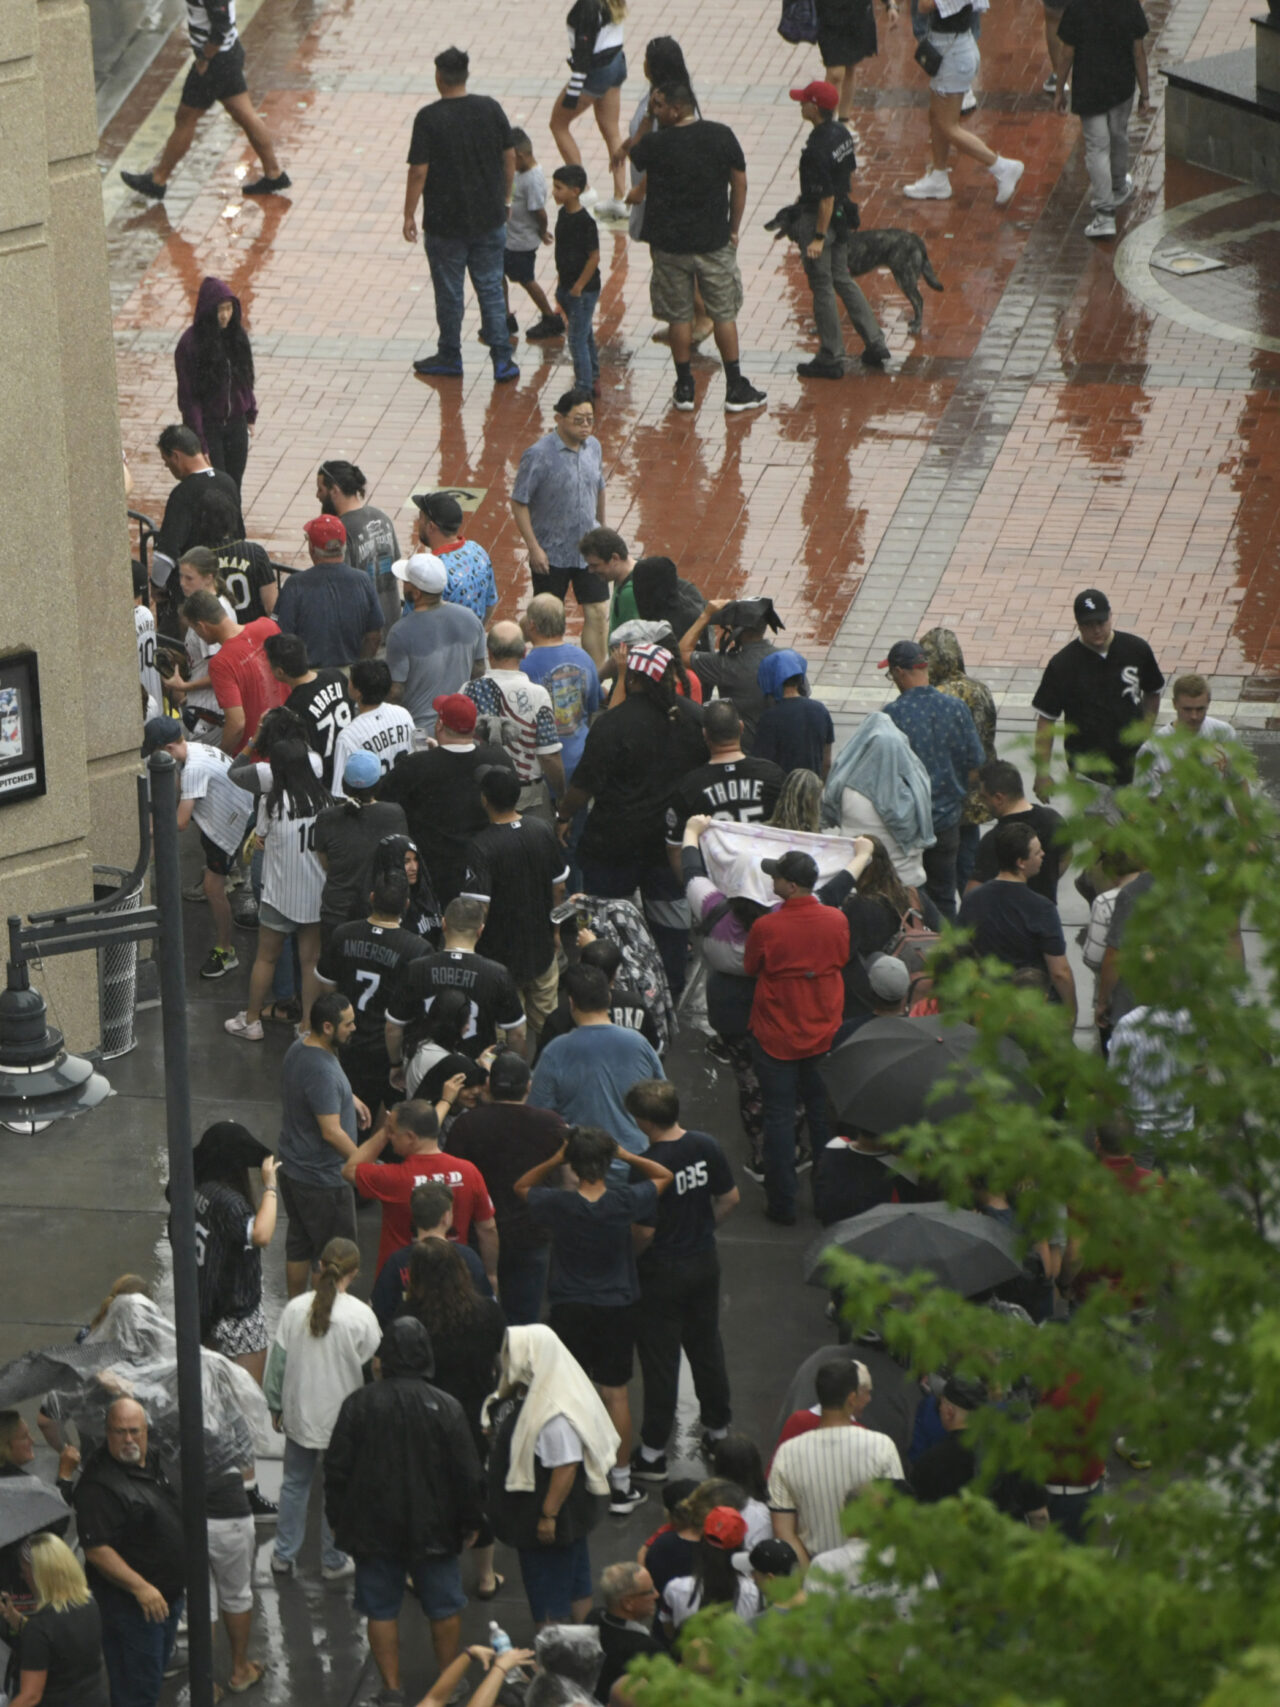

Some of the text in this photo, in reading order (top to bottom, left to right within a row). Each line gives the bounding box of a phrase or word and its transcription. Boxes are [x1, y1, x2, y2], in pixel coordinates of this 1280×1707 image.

[308, 681, 343, 719] ABREU
[316, 701, 352, 758] 79
[362, 724, 409, 753] ROBERT
[0, 772, 34, 788] PITCHER
[703, 779, 764, 806] THOME
[344, 939, 400, 969] ANDERSON
[356, 969, 381, 1012] 7
[431, 967, 478, 988] ROBERT
